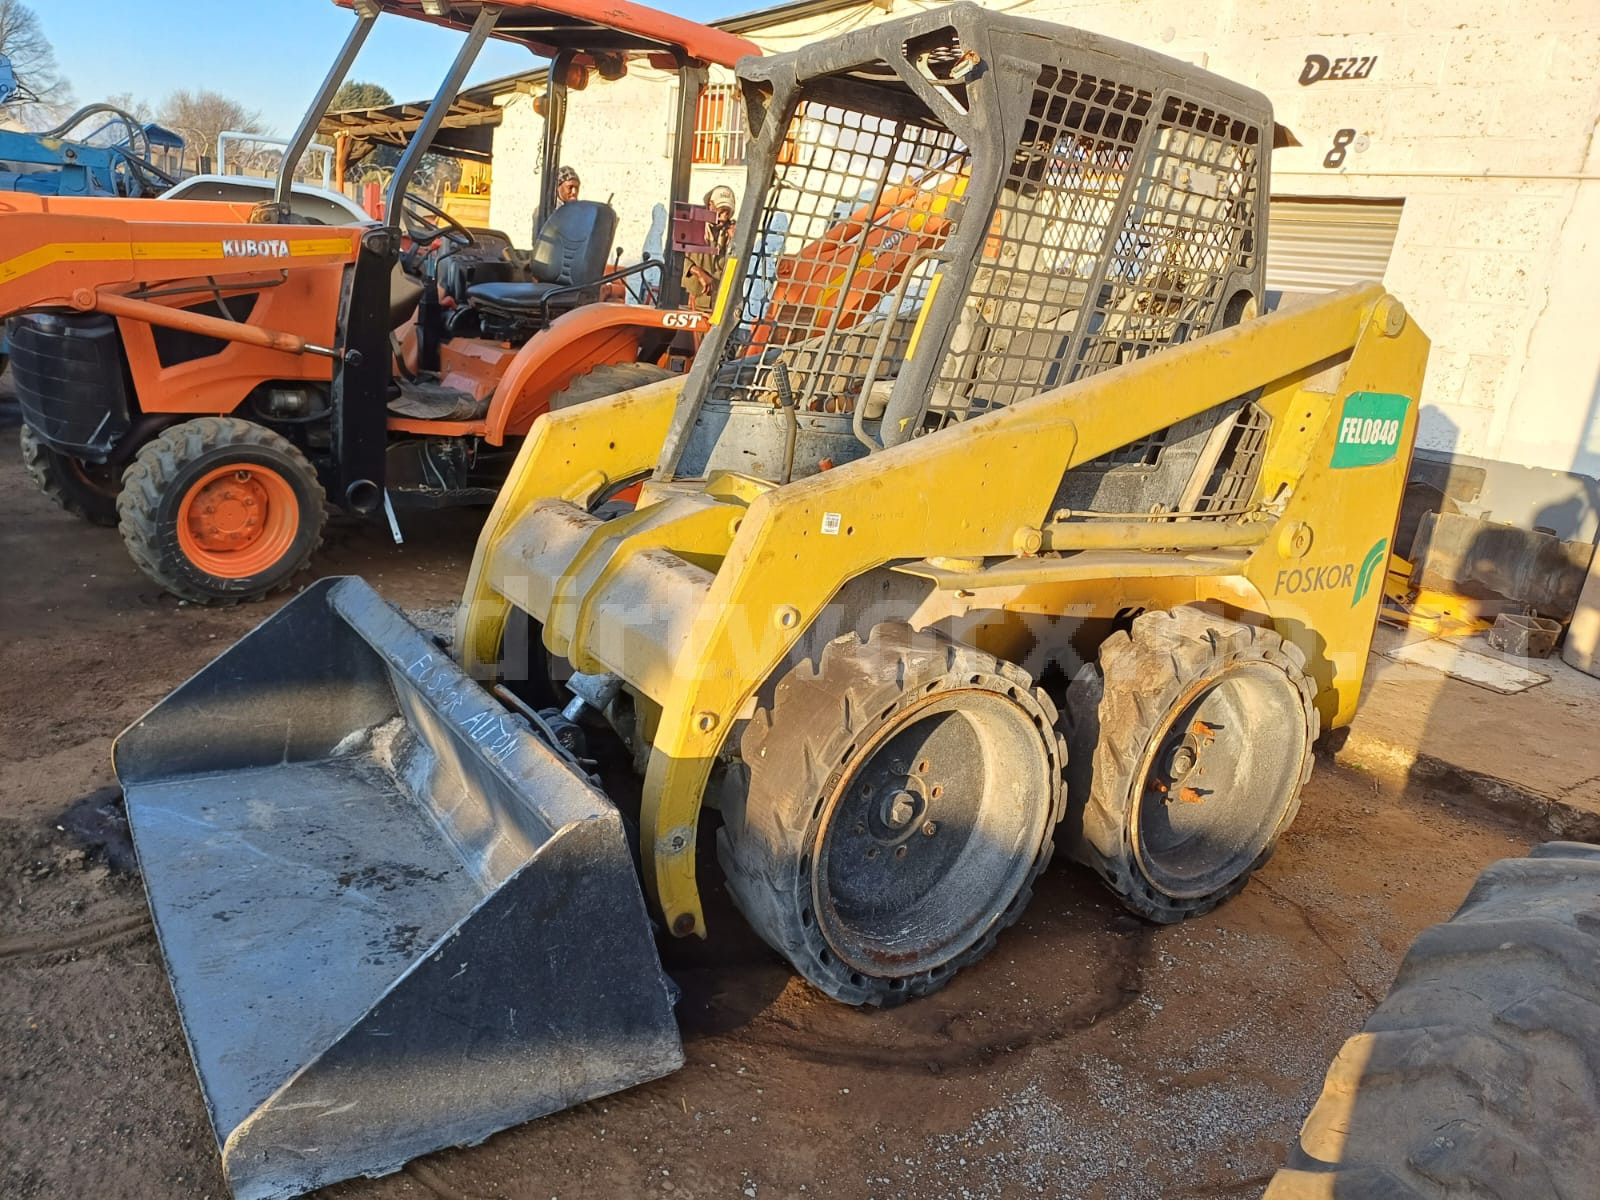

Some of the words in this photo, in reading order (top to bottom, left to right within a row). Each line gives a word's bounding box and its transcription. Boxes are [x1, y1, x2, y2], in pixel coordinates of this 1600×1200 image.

[1323, 128, 1356, 169] 8
[222, 239, 289, 258] KUBOTA
[662, 313, 702, 329] GST
[1274, 563, 1355, 596] FOSKOR
